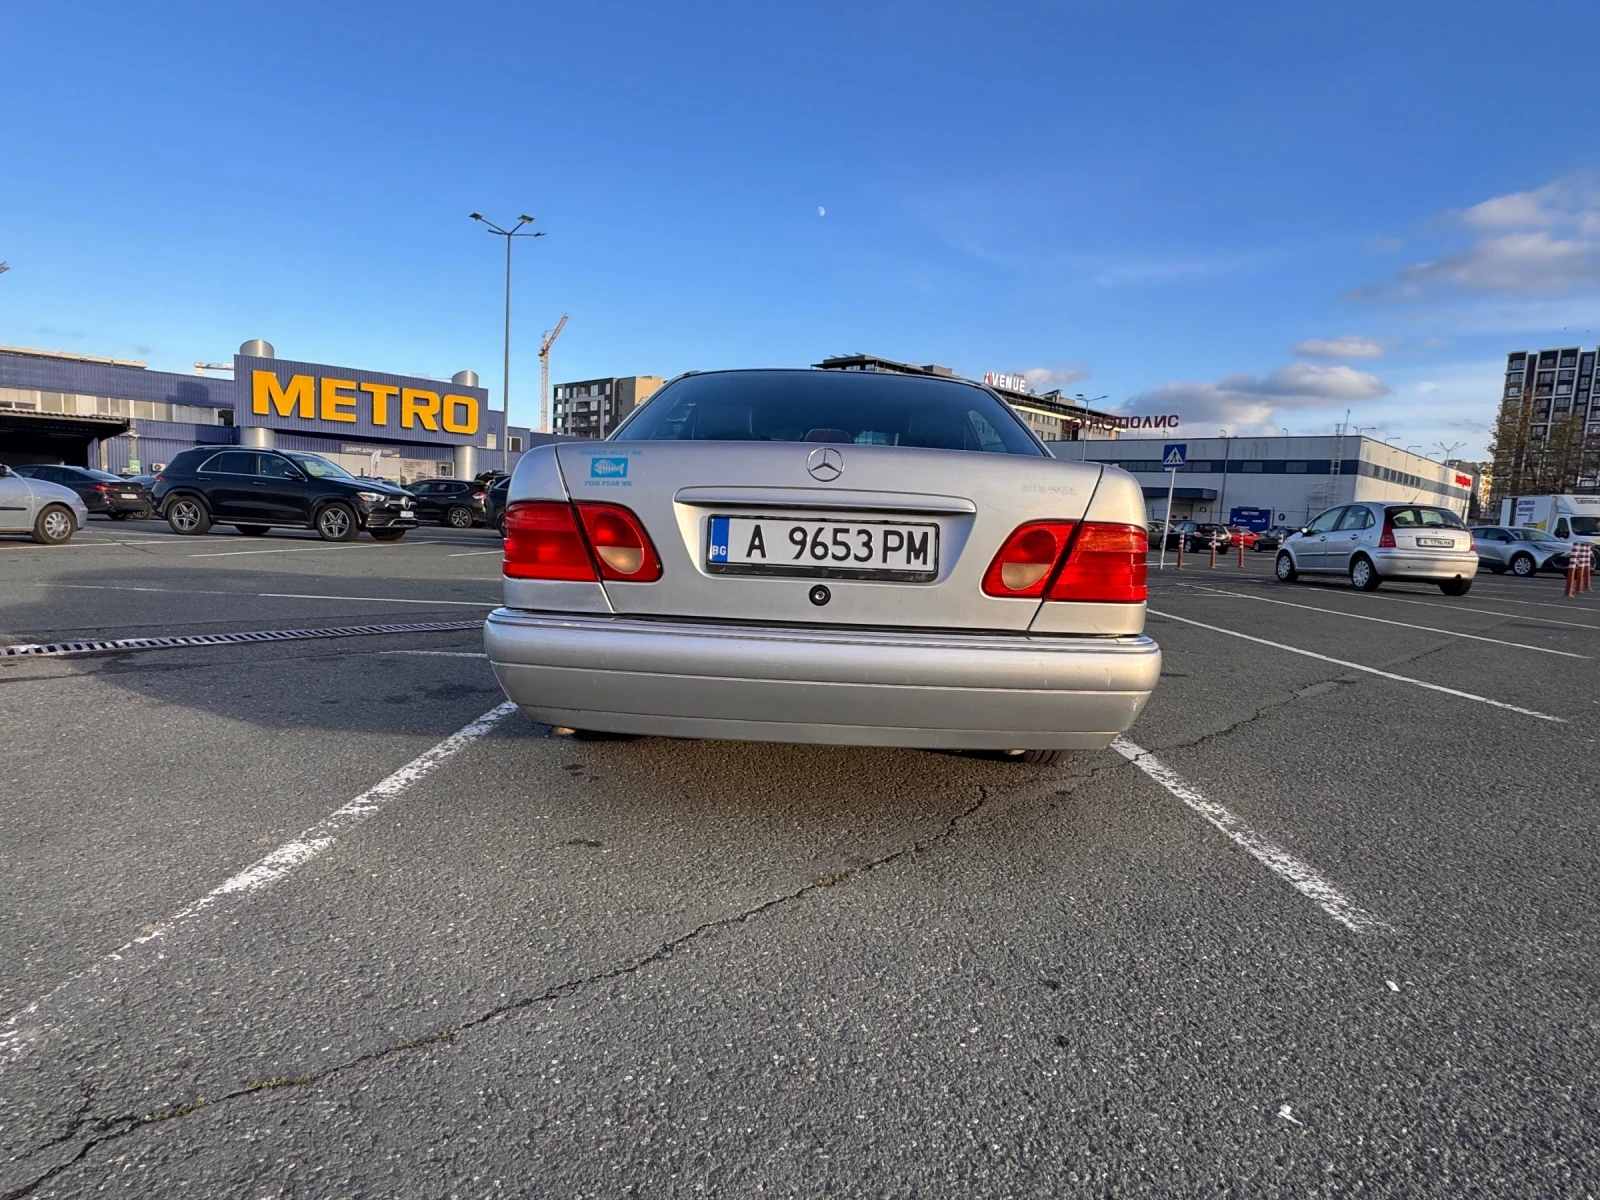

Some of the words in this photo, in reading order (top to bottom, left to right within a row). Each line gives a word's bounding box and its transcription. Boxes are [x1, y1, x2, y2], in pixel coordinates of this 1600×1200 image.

[984, 372, 1025, 392] AVENUE
[252, 370, 479, 434] METRO
[712, 545, 726, 556] BG
[746, 524, 767, 558] A
[788, 526, 874, 563] 9653
[882, 529, 929, 566] PM
